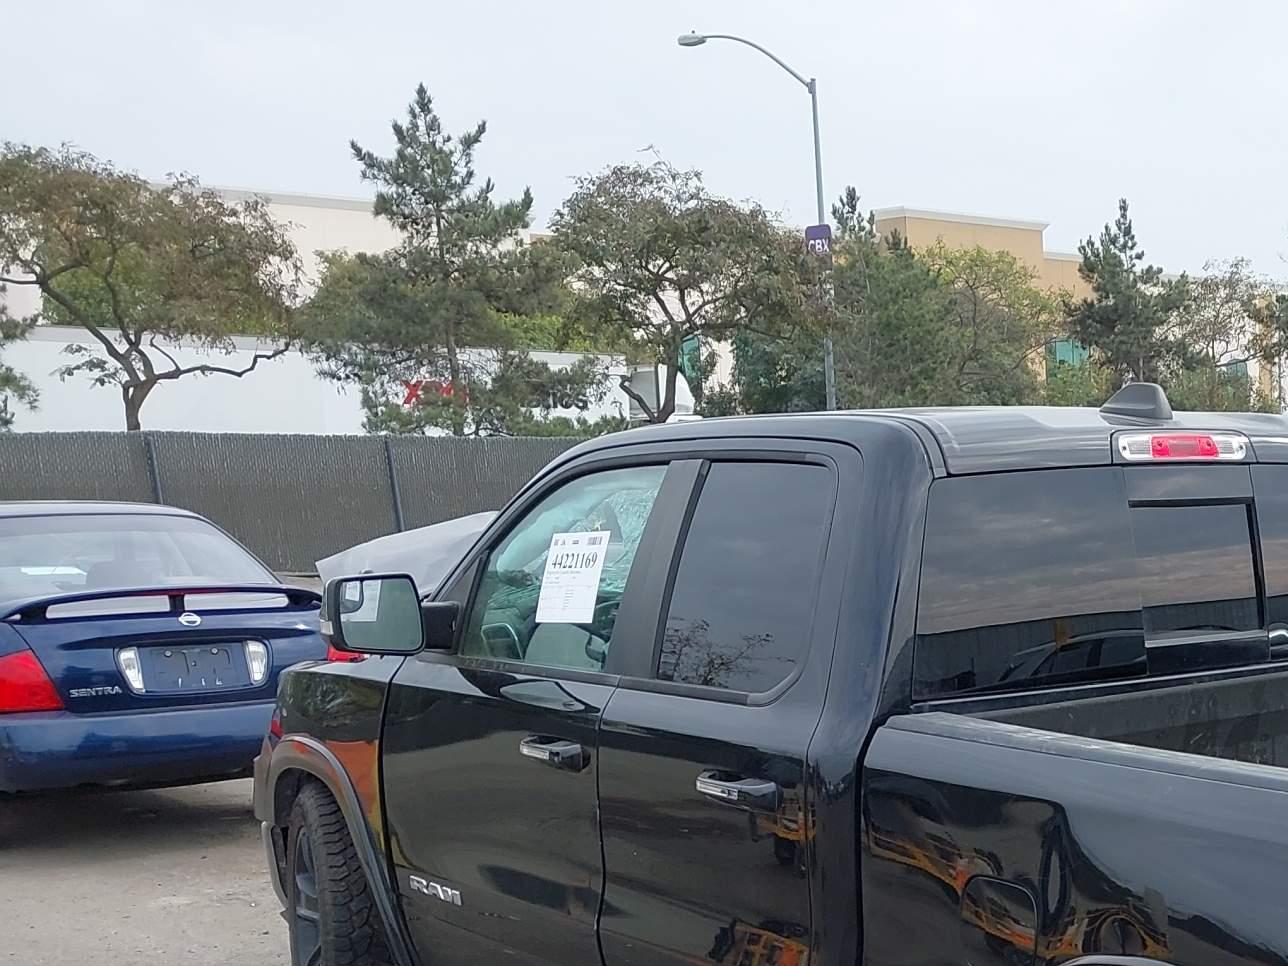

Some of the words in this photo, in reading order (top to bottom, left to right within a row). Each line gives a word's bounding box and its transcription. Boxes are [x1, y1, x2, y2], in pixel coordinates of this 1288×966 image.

[808, 239, 830, 252] CBX
[551, 551, 598, 569] 44221169
[69, 686, 122, 698] SENTRA
[409, 875, 462, 906] RAM
